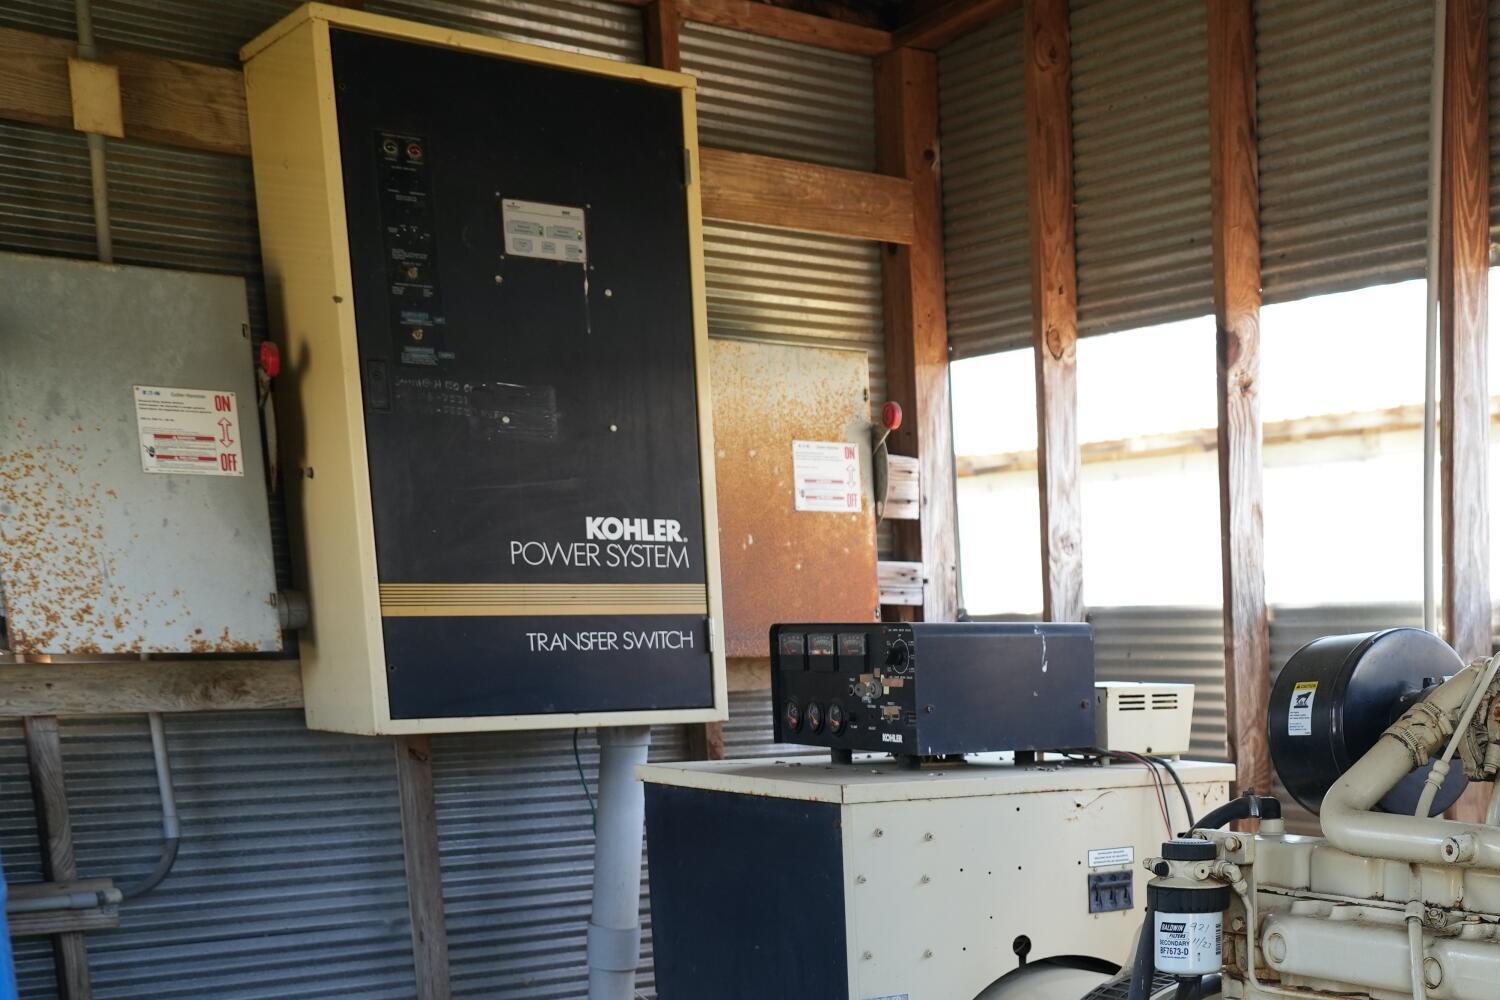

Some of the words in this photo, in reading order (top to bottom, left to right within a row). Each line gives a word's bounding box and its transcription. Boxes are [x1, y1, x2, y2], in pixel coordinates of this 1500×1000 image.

[214, 394, 232, 412] ON
[220, 452, 237, 472] OFF
[585, 516, 683, 542] KOHLER
[510, 541, 600, 566] POWER
[606, 543, 690, 568] SYSTEM
[526, 632, 619, 652] TRANSFER
[623, 630, 694, 650] SWITCH
[882, 733, 903, 743] KOHLER
[1161, 923, 1185, 932] BALDWIN
